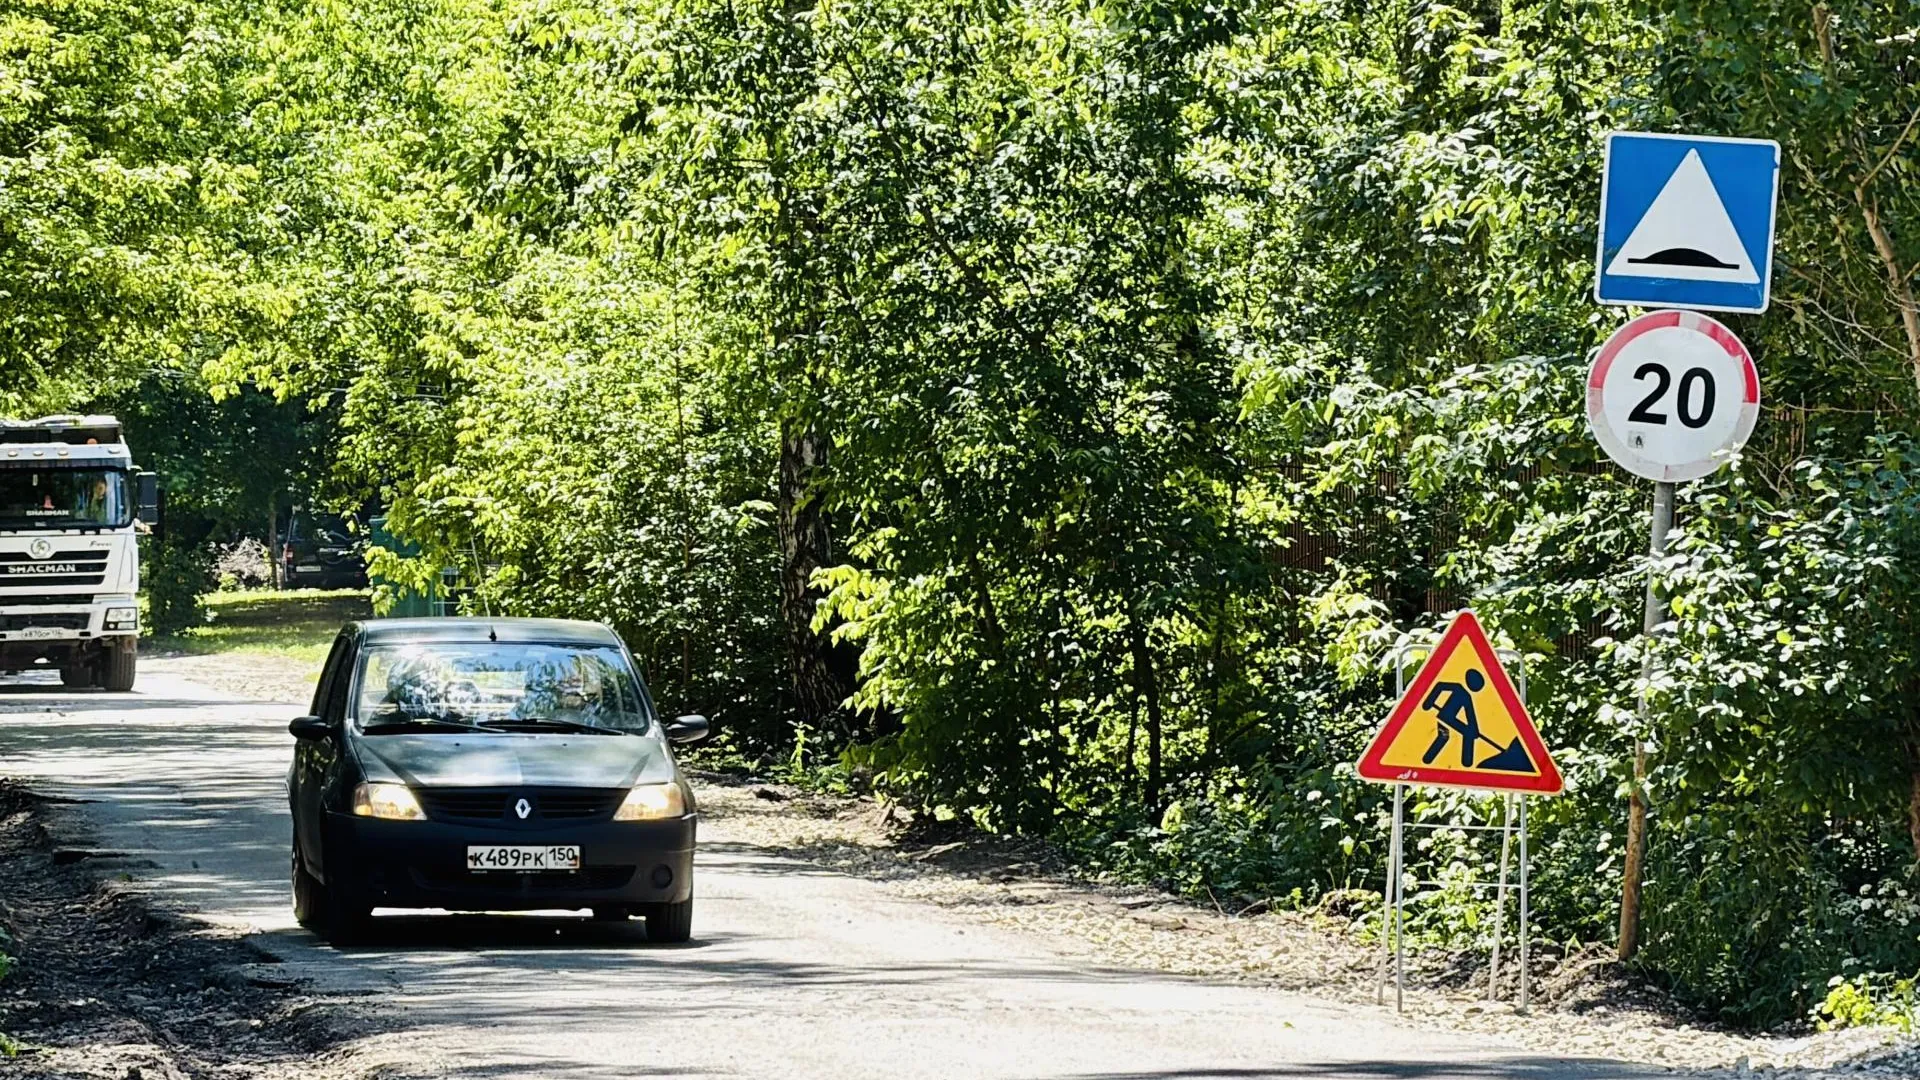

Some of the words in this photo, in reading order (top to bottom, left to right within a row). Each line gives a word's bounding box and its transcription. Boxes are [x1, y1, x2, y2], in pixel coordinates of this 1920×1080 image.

[1628, 362, 1716, 429] 20
[8, 564, 76, 574] SHACMAN
[473, 849, 545, 867] К489РК
[549, 847, 575, 861] 150
